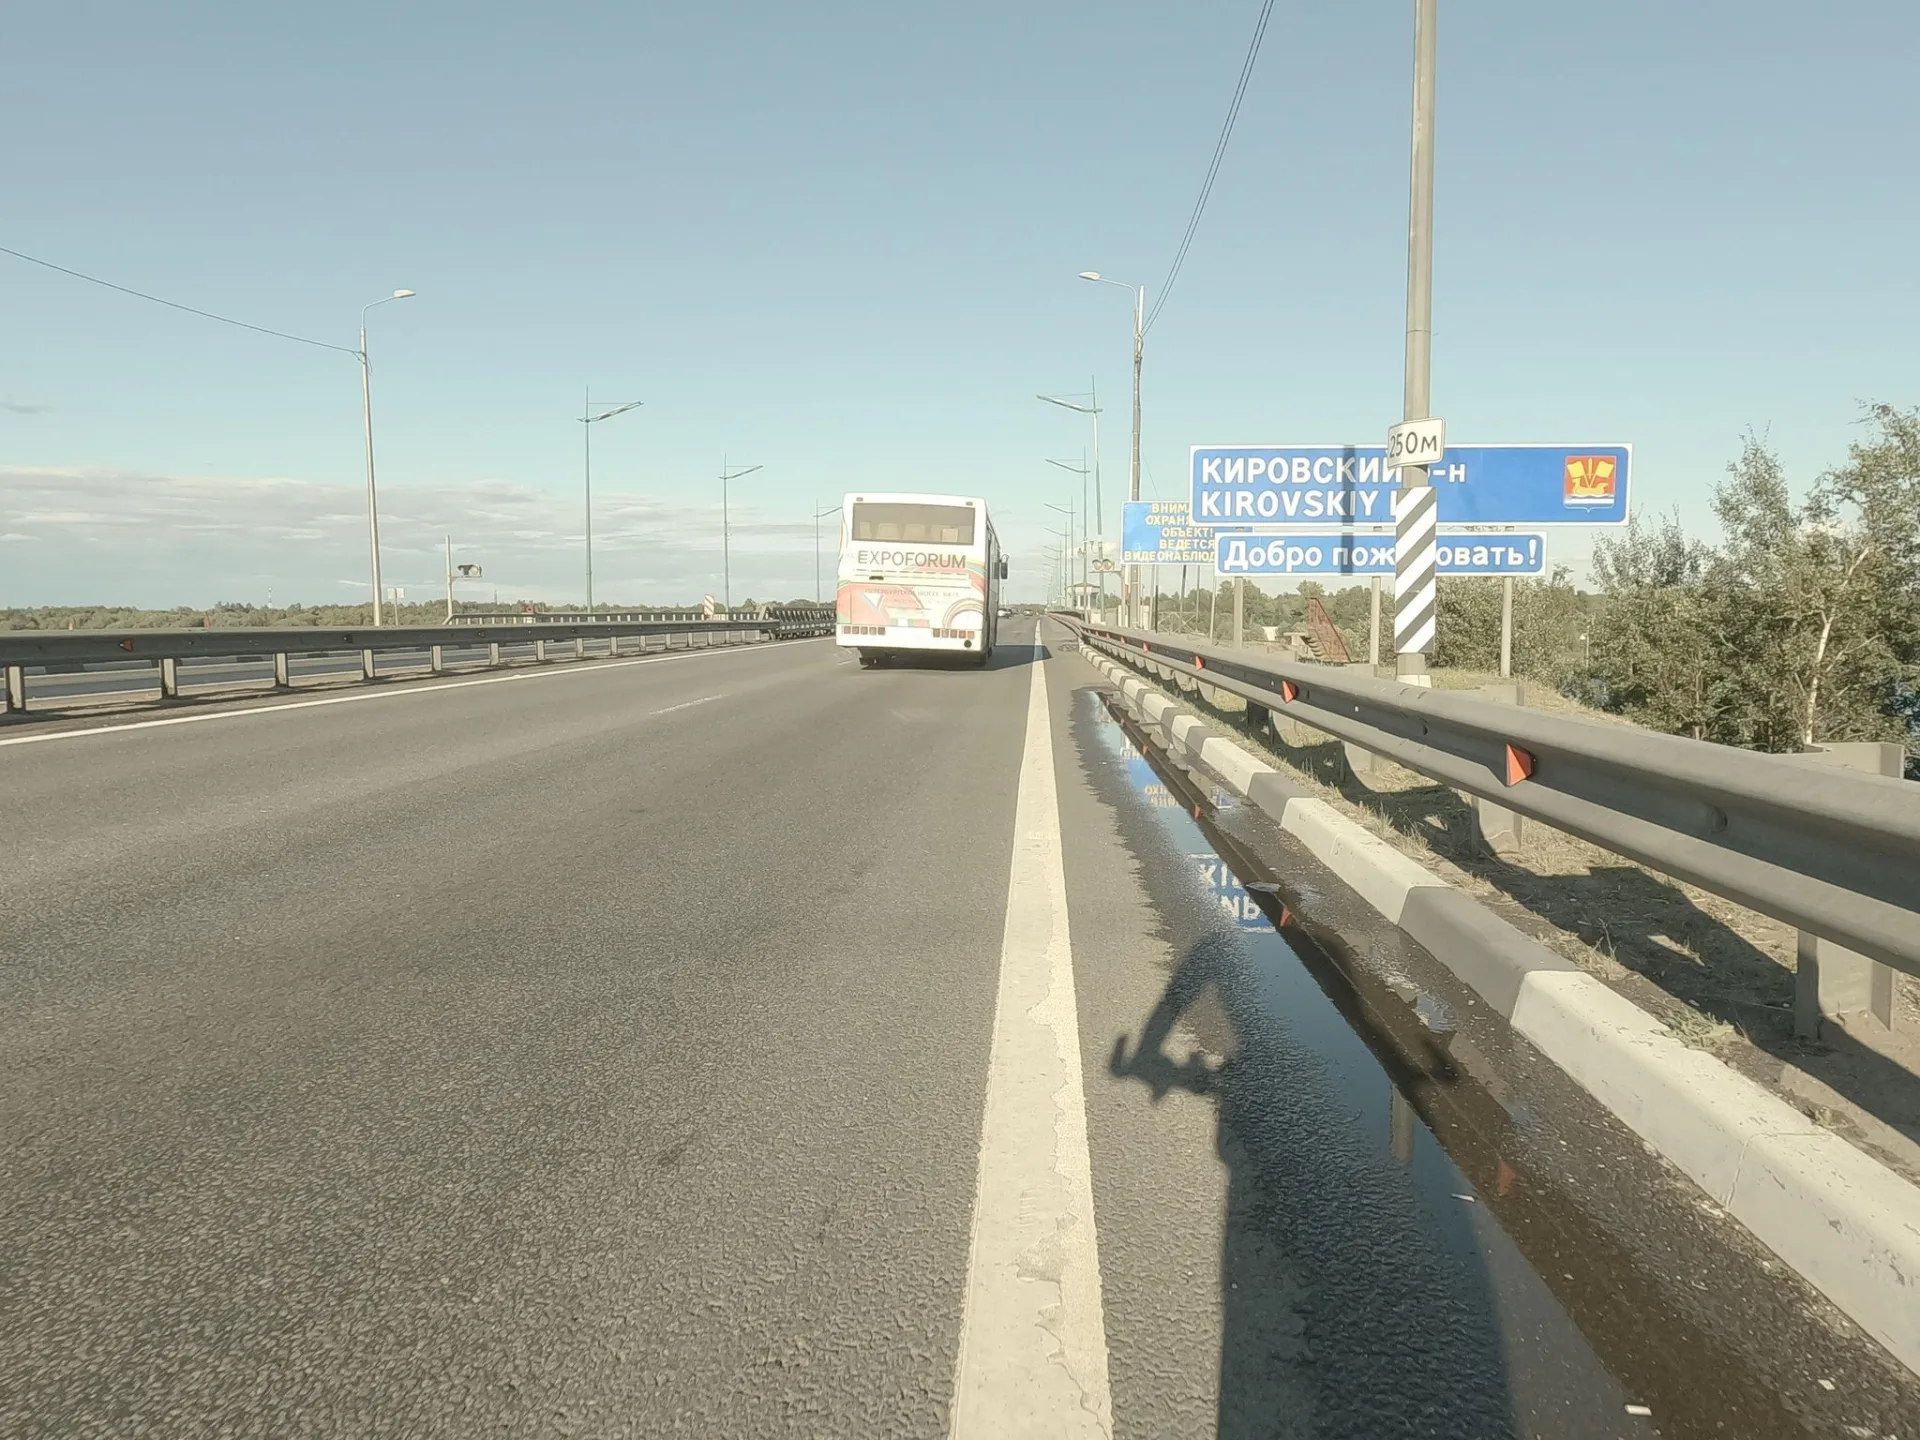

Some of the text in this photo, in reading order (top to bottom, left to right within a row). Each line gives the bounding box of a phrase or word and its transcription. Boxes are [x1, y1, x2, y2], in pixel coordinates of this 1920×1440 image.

[1427, 463, 1466, 483] -н
[1151, 503, 1189, 514] ВНИМ
[1201, 490, 1379, 517] KIROVSKIY
[857, 549, 967, 569] EXPOFORUM
[1124, 550, 1216, 562] ВИДЕОНАБЛЮД
[1223, 539, 1537, 572] Добро пожовать!
